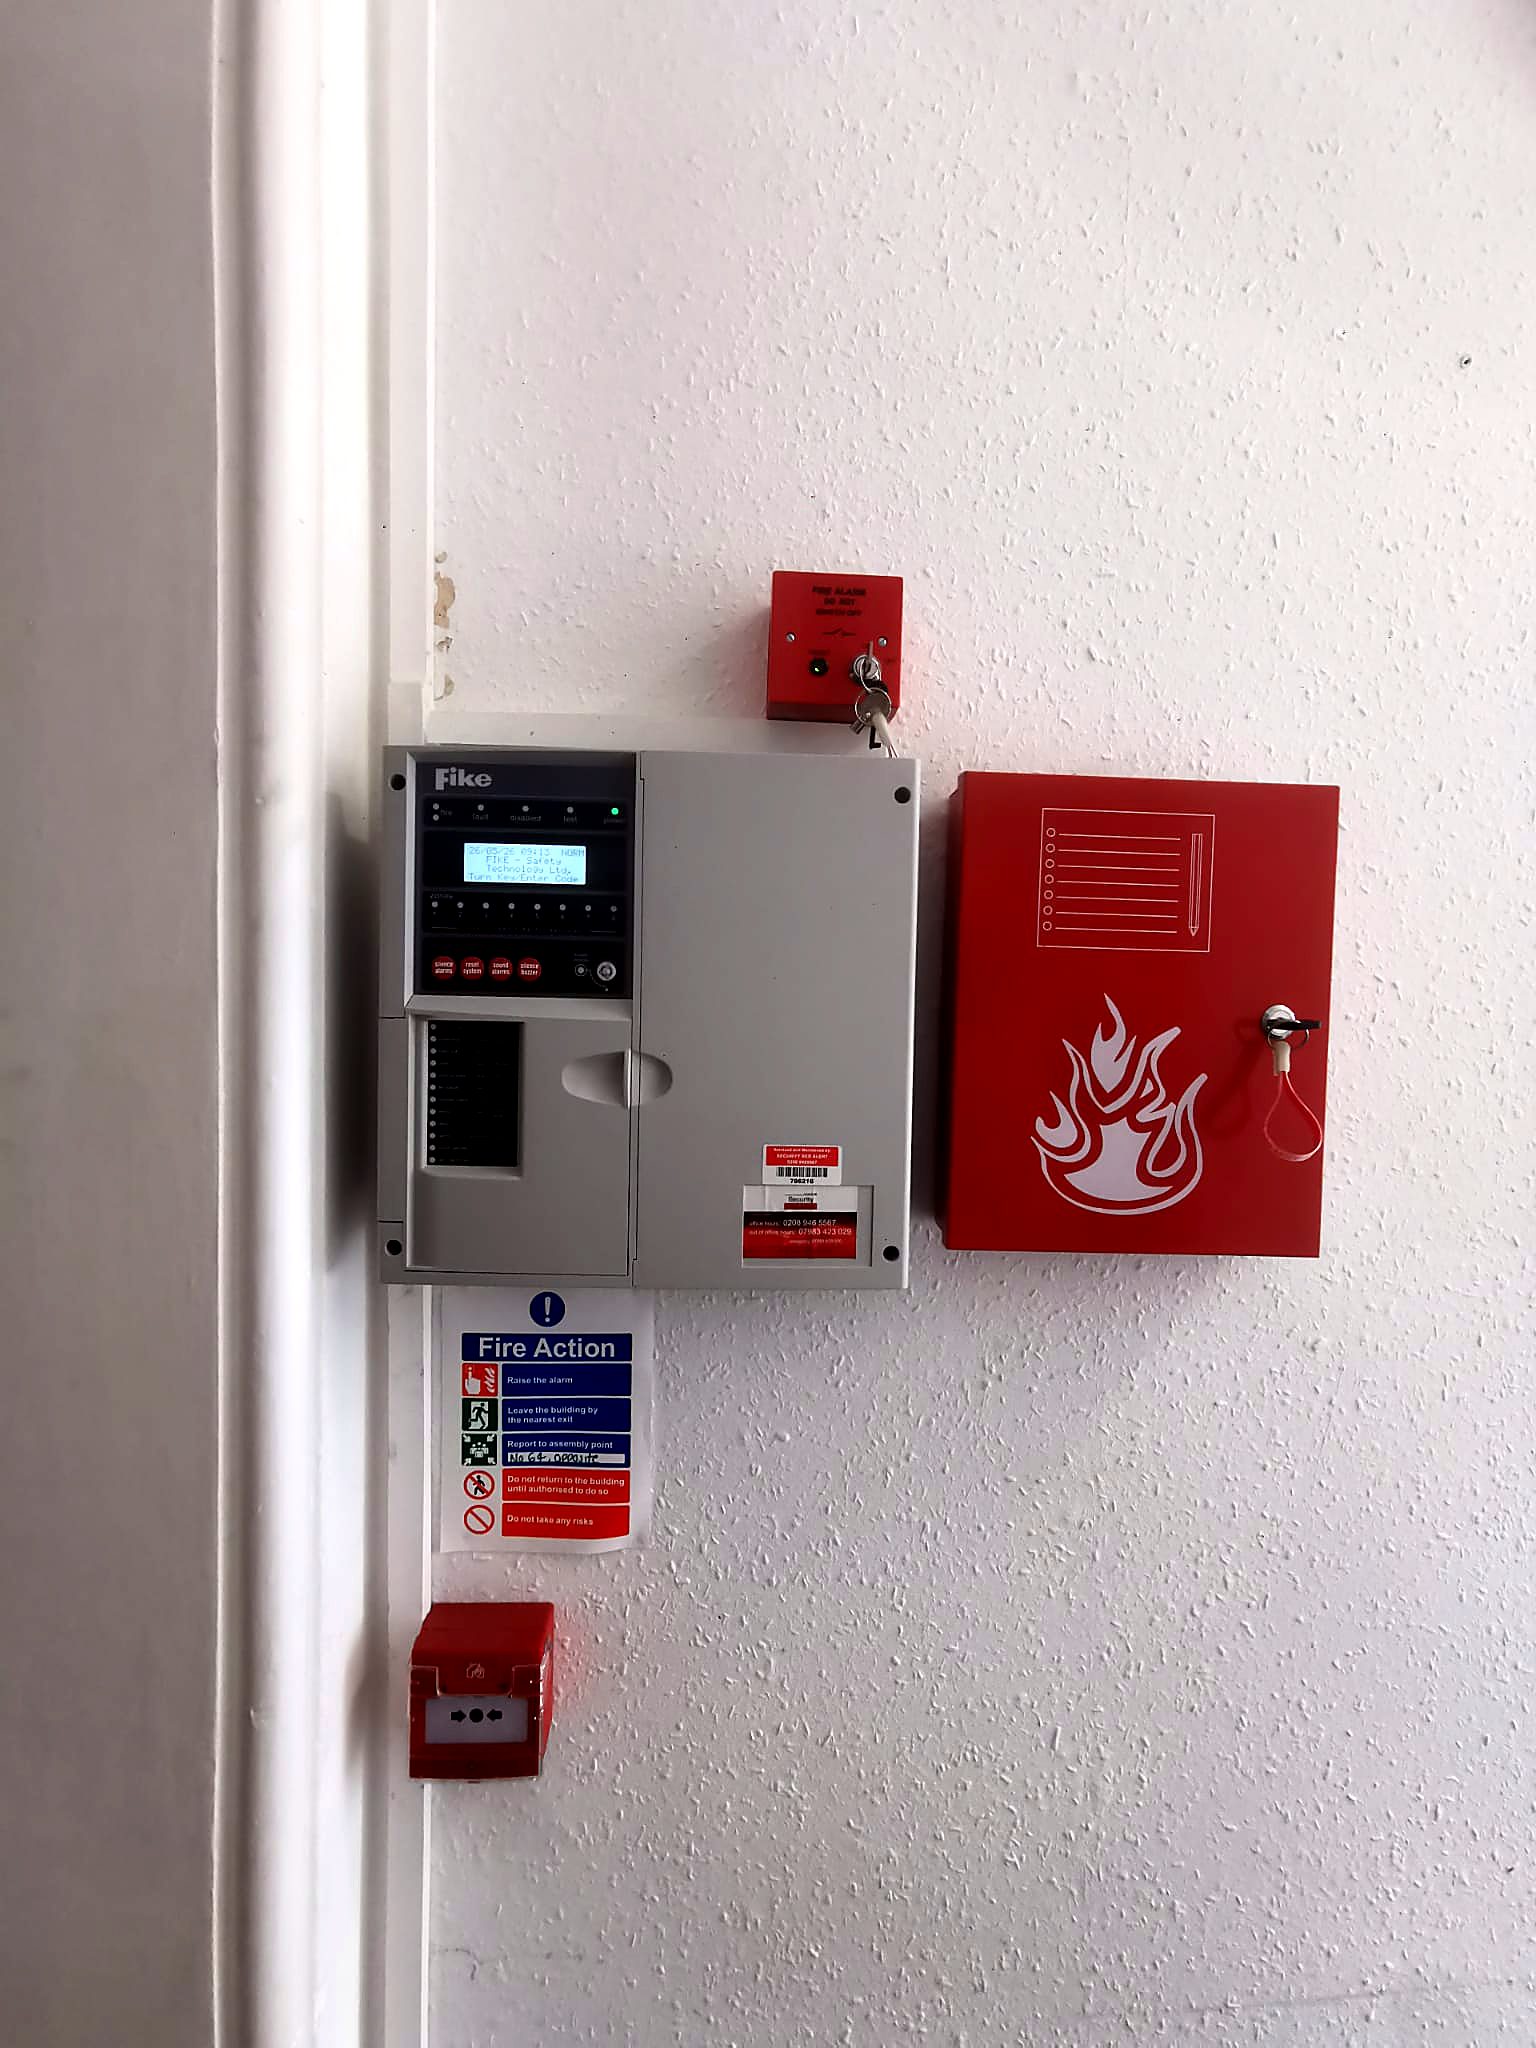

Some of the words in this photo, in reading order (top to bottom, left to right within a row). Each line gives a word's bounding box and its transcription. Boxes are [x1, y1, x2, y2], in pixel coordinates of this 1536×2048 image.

[435, 767, 492, 790] Fike
[486, 856, 509, 864] FIKE
[526, 857, 562, 865] Safety
[487, 864, 544, 873] Technology
[480, 1337, 526, 1357] Fire
[534, 1338, 615, 1357] Action
[551, 1407, 586, 1415] building
[588, 1407, 598, 1415] by
[550, 1441, 589, 1449] assembly
[509, 1453, 523, 1462] No
[537, 1476, 562, 1484] return
[590, 1478, 625, 1486] building
[528, 1486, 573, 1494] authorised
